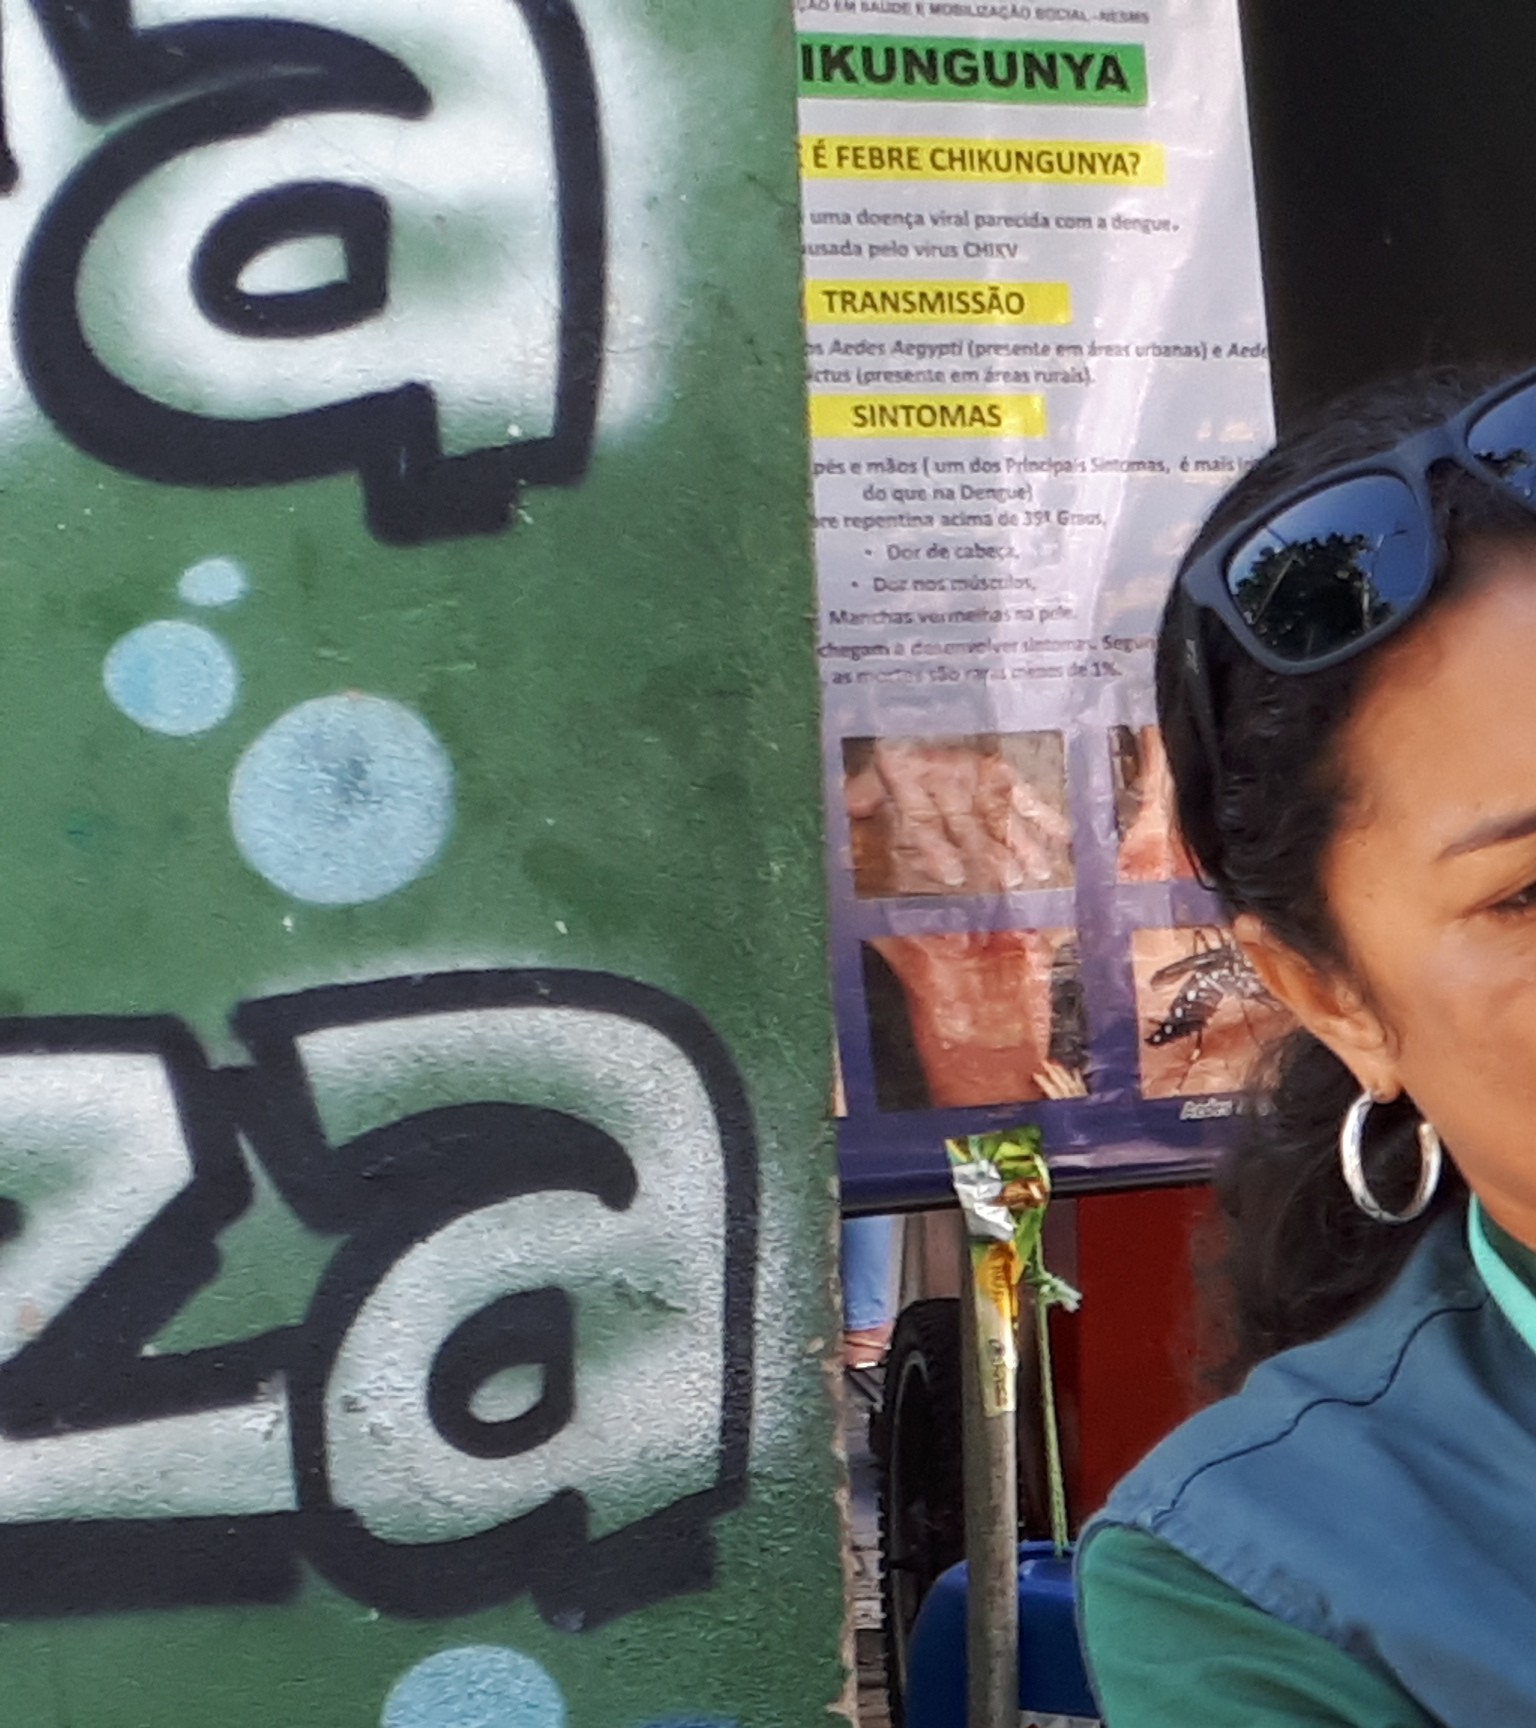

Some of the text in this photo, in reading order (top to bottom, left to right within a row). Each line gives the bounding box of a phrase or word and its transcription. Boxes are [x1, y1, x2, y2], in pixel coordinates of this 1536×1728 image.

[801, 43, 1131, 94] IKUNGUNYA
[813, 138, 1141, 177] É FEBRE CHIKUNGUNYA?
[810, 208, 1180, 234] uma doença viral parecida com a dengue.
[868, 240, 909, 260] pelo
[963, 242, 1018, 258] CHIKV
[822, 286, 1025, 316] TRANSMISSÃO
[828, 339, 886, 355] Aedes
[967, 340, 1049, 359] (presente
[1055, 344, 1083, 356] em
[1087, 340, 1131, 357] áreas
[1135, 341, 1208, 360] urbanas)
[1213, 347, 1223, 357] e
[856, 366, 946, 386] (presente
[951, 371, 979, 383] em
[984, 366, 1030, 383] áreas
[852, 404, 1003, 428] SINTOMAS
[850, 462, 862, 474] e
[866, 456, 918, 474] mãos
[934, 461, 965, 474] um
[969, 456, 1001, 473] dos
[1005, 456, 1087, 476] Principais
[1091, 457, 1171, 475] Sintomas,
[1179, 455, 1190, 473] é
[1194, 458, 1235, 472] mais
[862, 484, 1033, 504] do que na Dengue)
[843, 514, 935, 531] repentina
[941, 513, 993, 527] acima
[998, 511, 1019, 526] de
[886, 544, 921, 560] Dor
[925, 543, 950, 559] de
[872, 577, 907, 591] Dor
[912, 578, 945, 591] nos
[829, 610, 914, 624] Manchas
[917, 608, 1011, 623] vermelhas
[818, 642, 890, 661] chegam
